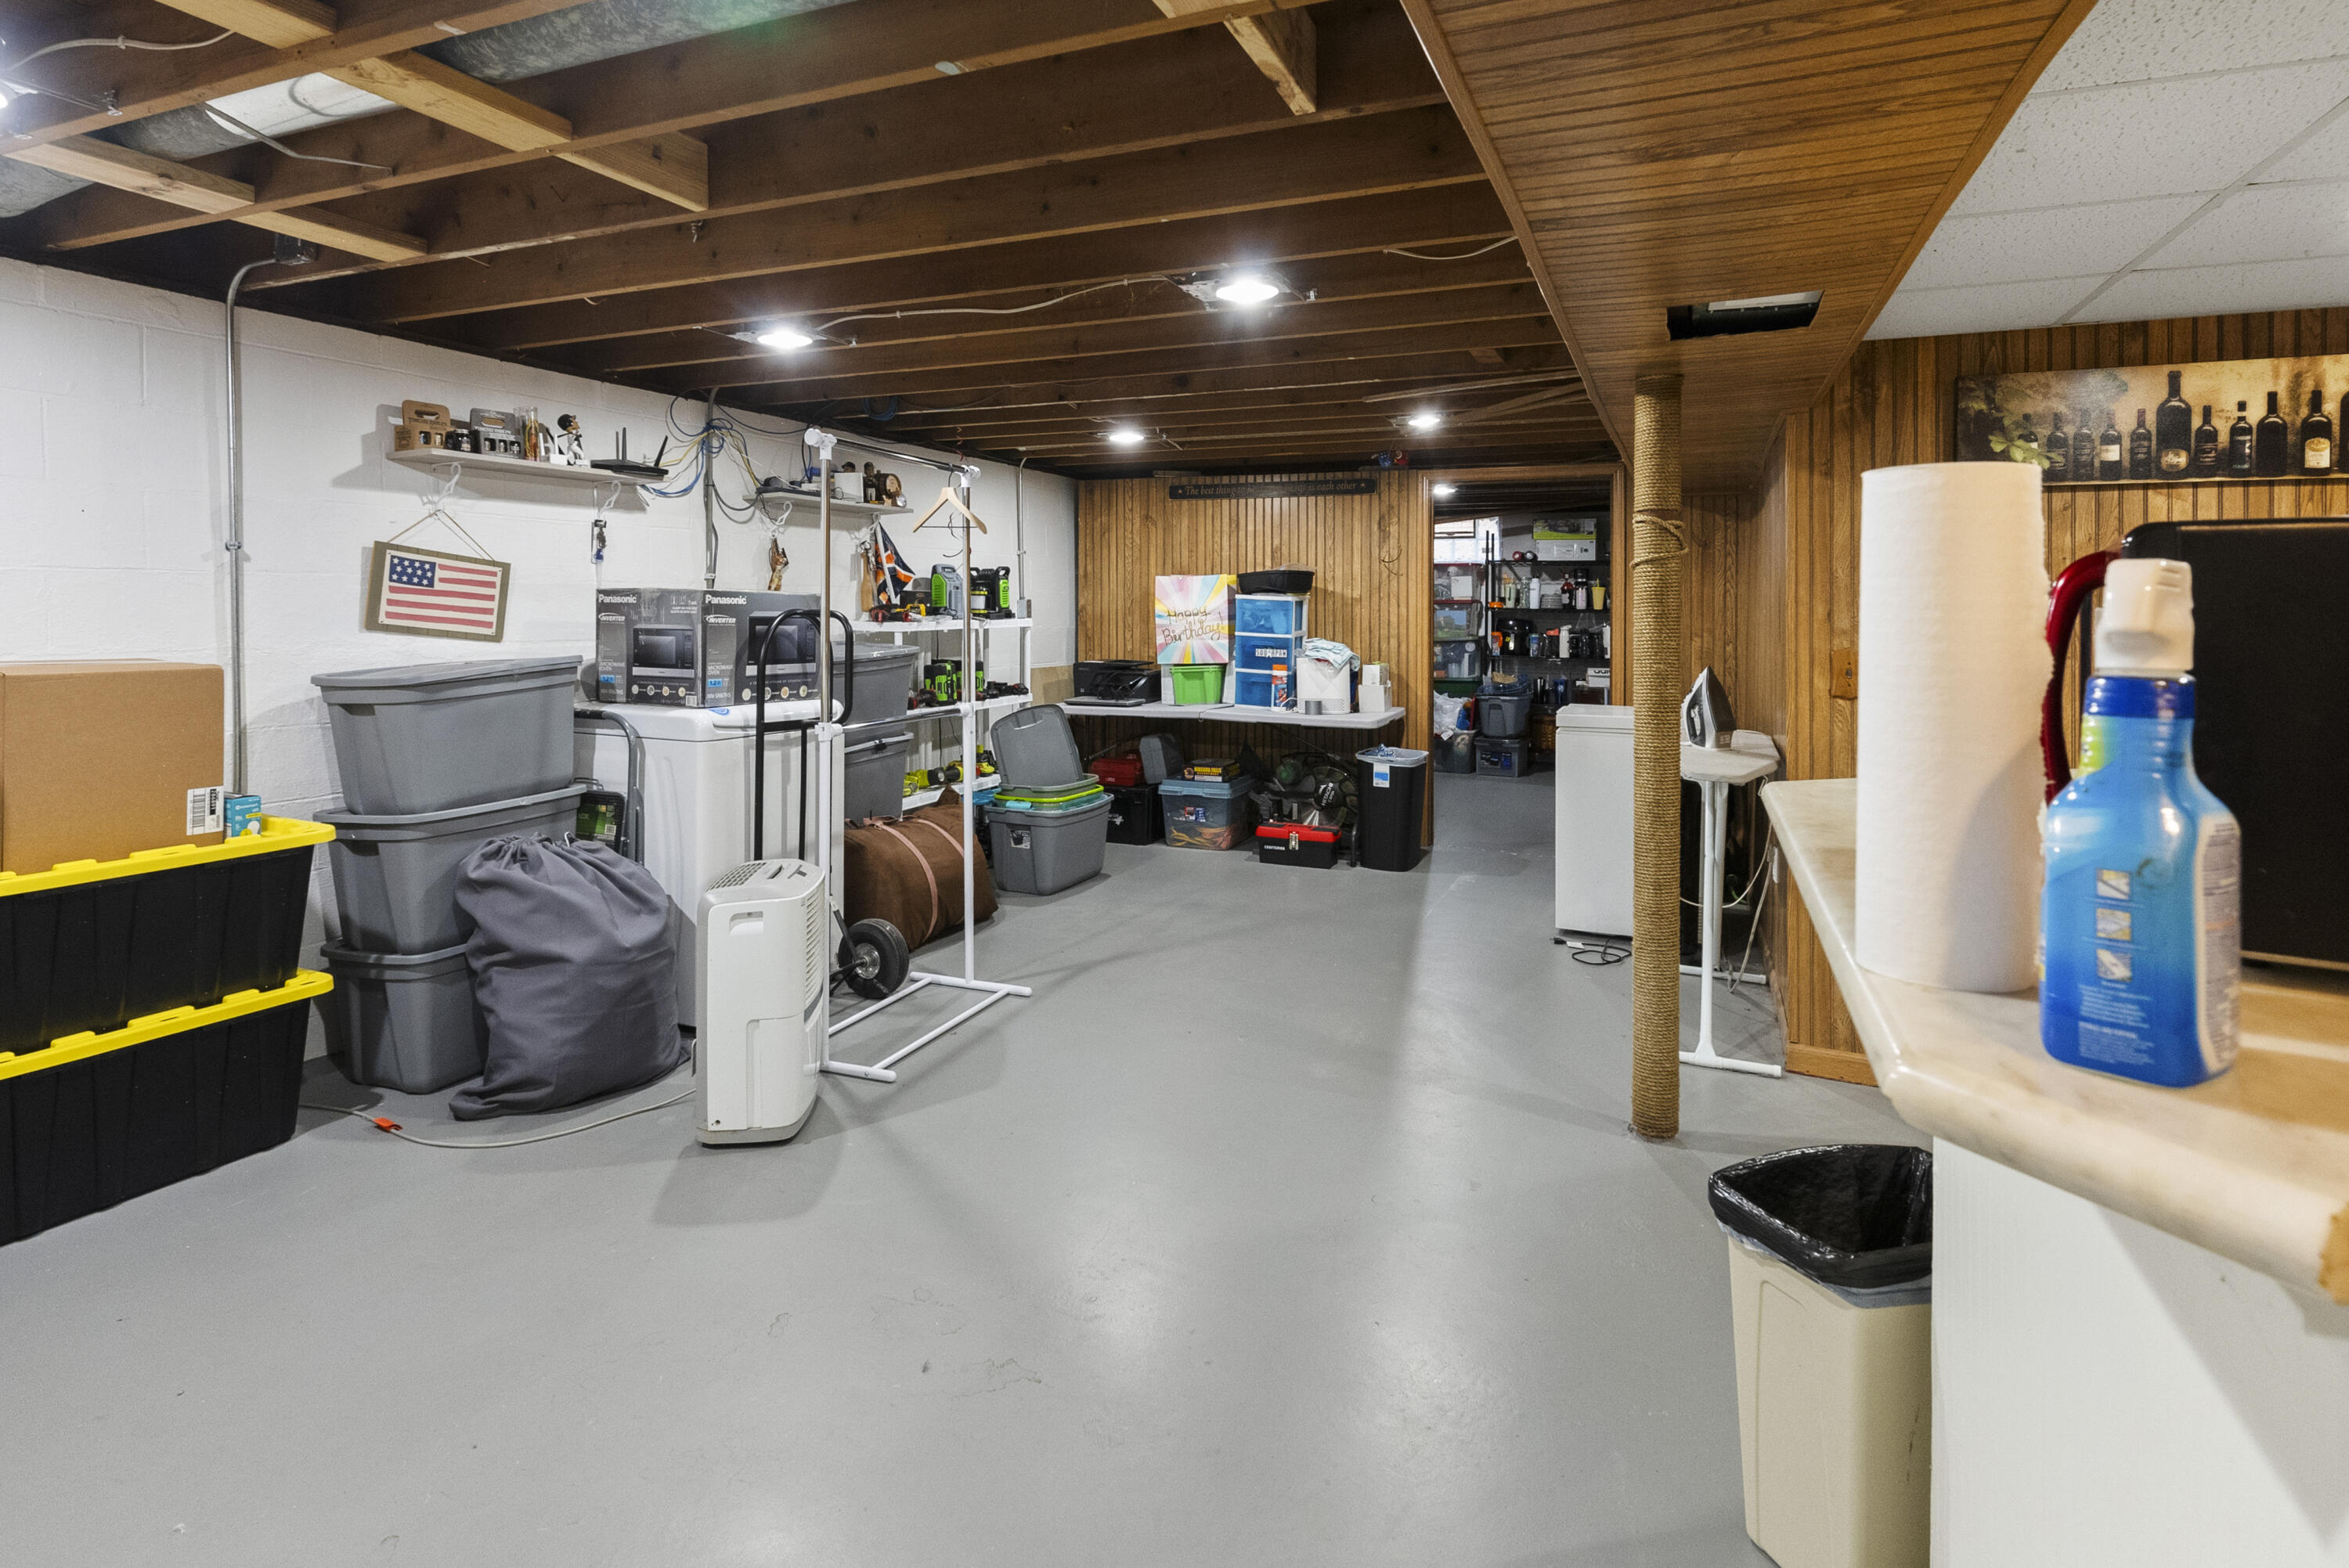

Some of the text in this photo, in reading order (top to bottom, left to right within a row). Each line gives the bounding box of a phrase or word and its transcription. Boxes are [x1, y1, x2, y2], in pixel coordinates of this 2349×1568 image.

[1185, 485, 1199, 495] The
[1200, 485, 1214, 495] best
[1215, 485, 1236, 498] thing
[1317, 481, 1334, 491] each
[1336, 480, 1356, 490] other
[598, 593, 637, 604] Panasonic
[705, 593, 747, 604] Panasonic
[1167, 606, 1211, 625] Happy
